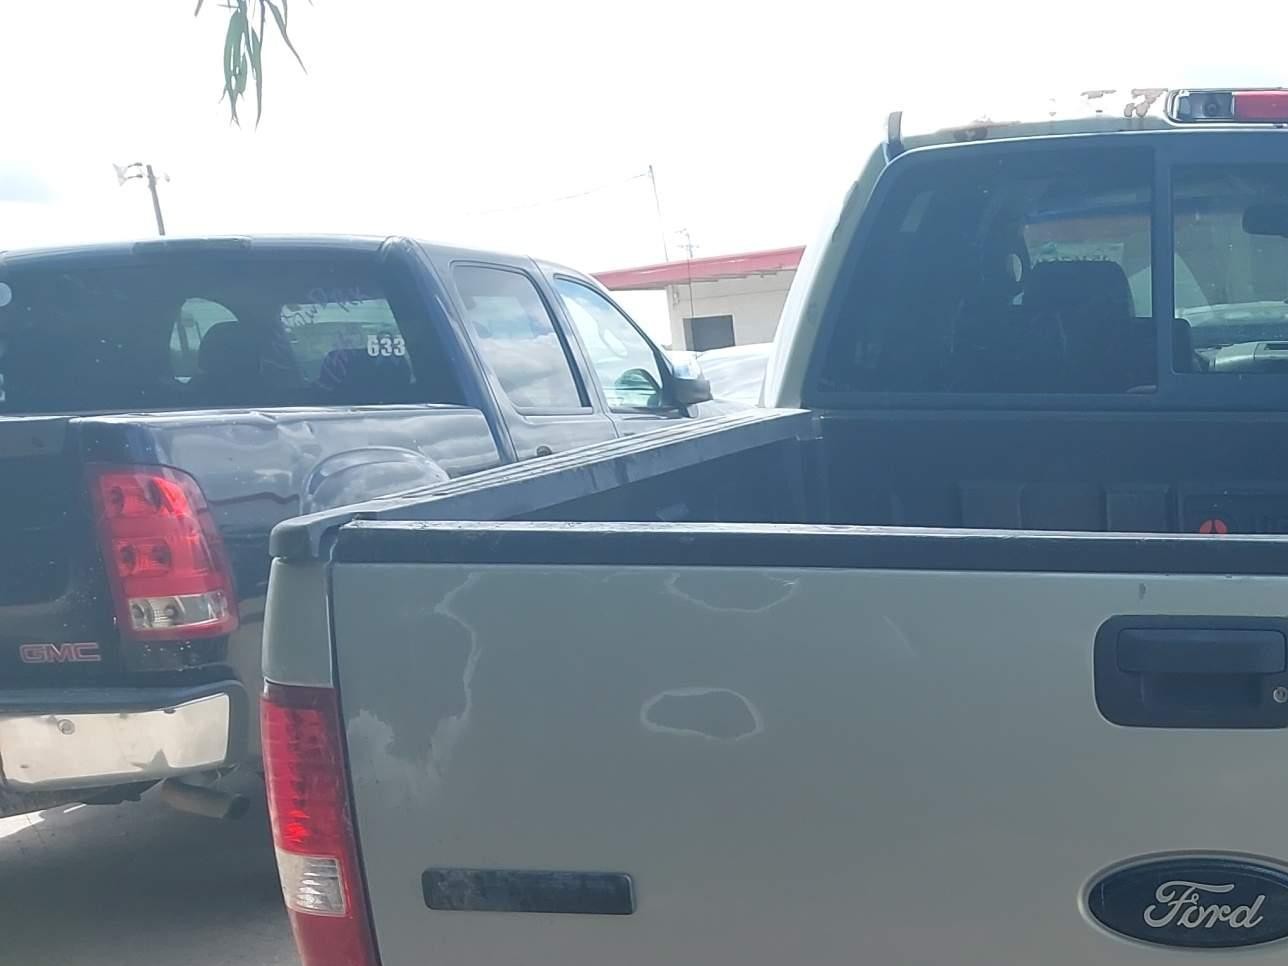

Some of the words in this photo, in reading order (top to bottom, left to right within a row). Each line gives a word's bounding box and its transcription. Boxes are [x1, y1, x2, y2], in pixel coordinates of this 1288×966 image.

[367, 334, 406, 357] 633
[19, 642, 101, 663] GMC
[1143, 880, 1266, 928] Ford
